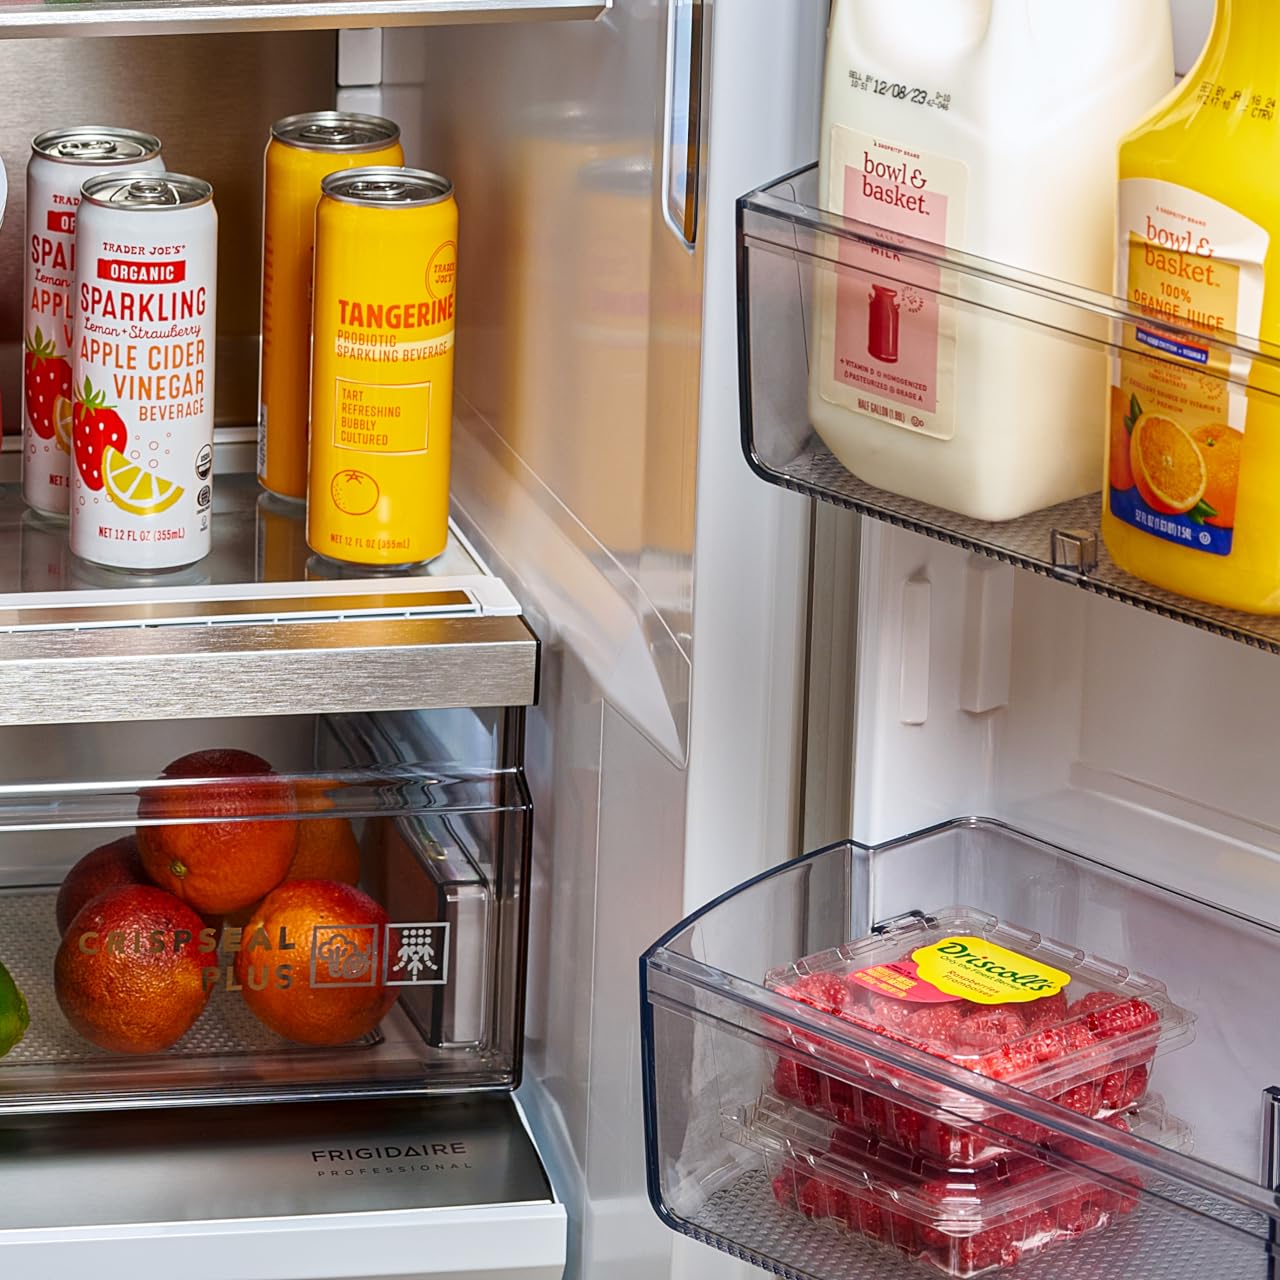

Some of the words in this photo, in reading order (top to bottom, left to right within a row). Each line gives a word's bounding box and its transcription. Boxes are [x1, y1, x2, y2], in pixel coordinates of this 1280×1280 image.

[848, 70, 863, 81] SELL
[865, 75, 874, 83] BY
[873, 79, 928, 105] 12/08/23
[863, 151, 907, 185] bowl
[910, 168, 928, 189] &
[1145, 214, 1192, 255] bowl
[1195, 237, 1215, 259] &
[103, 242, 145, 256] TRADER
[34, 268, 70, 287] Lemon
[110, 263, 175, 281] ORGANIC
[80, 282, 207, 322] SPARKLING
[1160, 282, 1192, 304] 100%
[338, 293, 454, 330] TANGERINE
[83, 316, 120, 337] Lemon
[128, 324, 202, 339] Strawberry
[337, 329, 397, 347] PROBIOTIC
[80, 335, 137, 370] APPLE
[147, 338, 206, 371] CIDER
[336, 344, 399, 363] SPARKLING
[402, 341, 449, 362] BEVERAGE
[845, 359, 869, 374] VITAMIN
[113, 369, 205, 401] VINEGAR
[849, 371, 889, 391] PASTEURIZED
[883, 373, 928, 392] HOMOGENIZED
[341, 388, 364, 402] TART
[138, 397, 205, 422] BEVERAGE
[341, 402, 401, 418] REFRESHING
[341, 416, 377, 431] BUBBLY
[340, 430, 389, 446] CULTURED
[49, 474, 64, 486] NET
[98, 526, 113, 539] NET
[114, 528, 125, 540] 12
[127, 529, 138, 542] FL
[139, 530, 151, 542] OZ
[153, 527, 186, 542] (355mL)
[330, 533, 343, 545] NET
[344, 535, 353, 546] 12
[355, 536, 365, 547] FL
[366, 537, 376, 549] OZ
[78, 926, 296, 955] CRISPSEAL
[937, 941, 1053, 991] Driscoll's
[940, 955, 958, 966] Only
[958, 963, 970, 972] the
[973, 967, 994, 981] Finest
[201, 963, 294, 993] PLUS
[942, 974, 994, 998] Framboises
[947, 970, 1001, 994] Raspberries
[311, 1142, 468, 1163] FRIGIDAIRE
[318, 1162, 472, 1177] PROFESSIONAL
